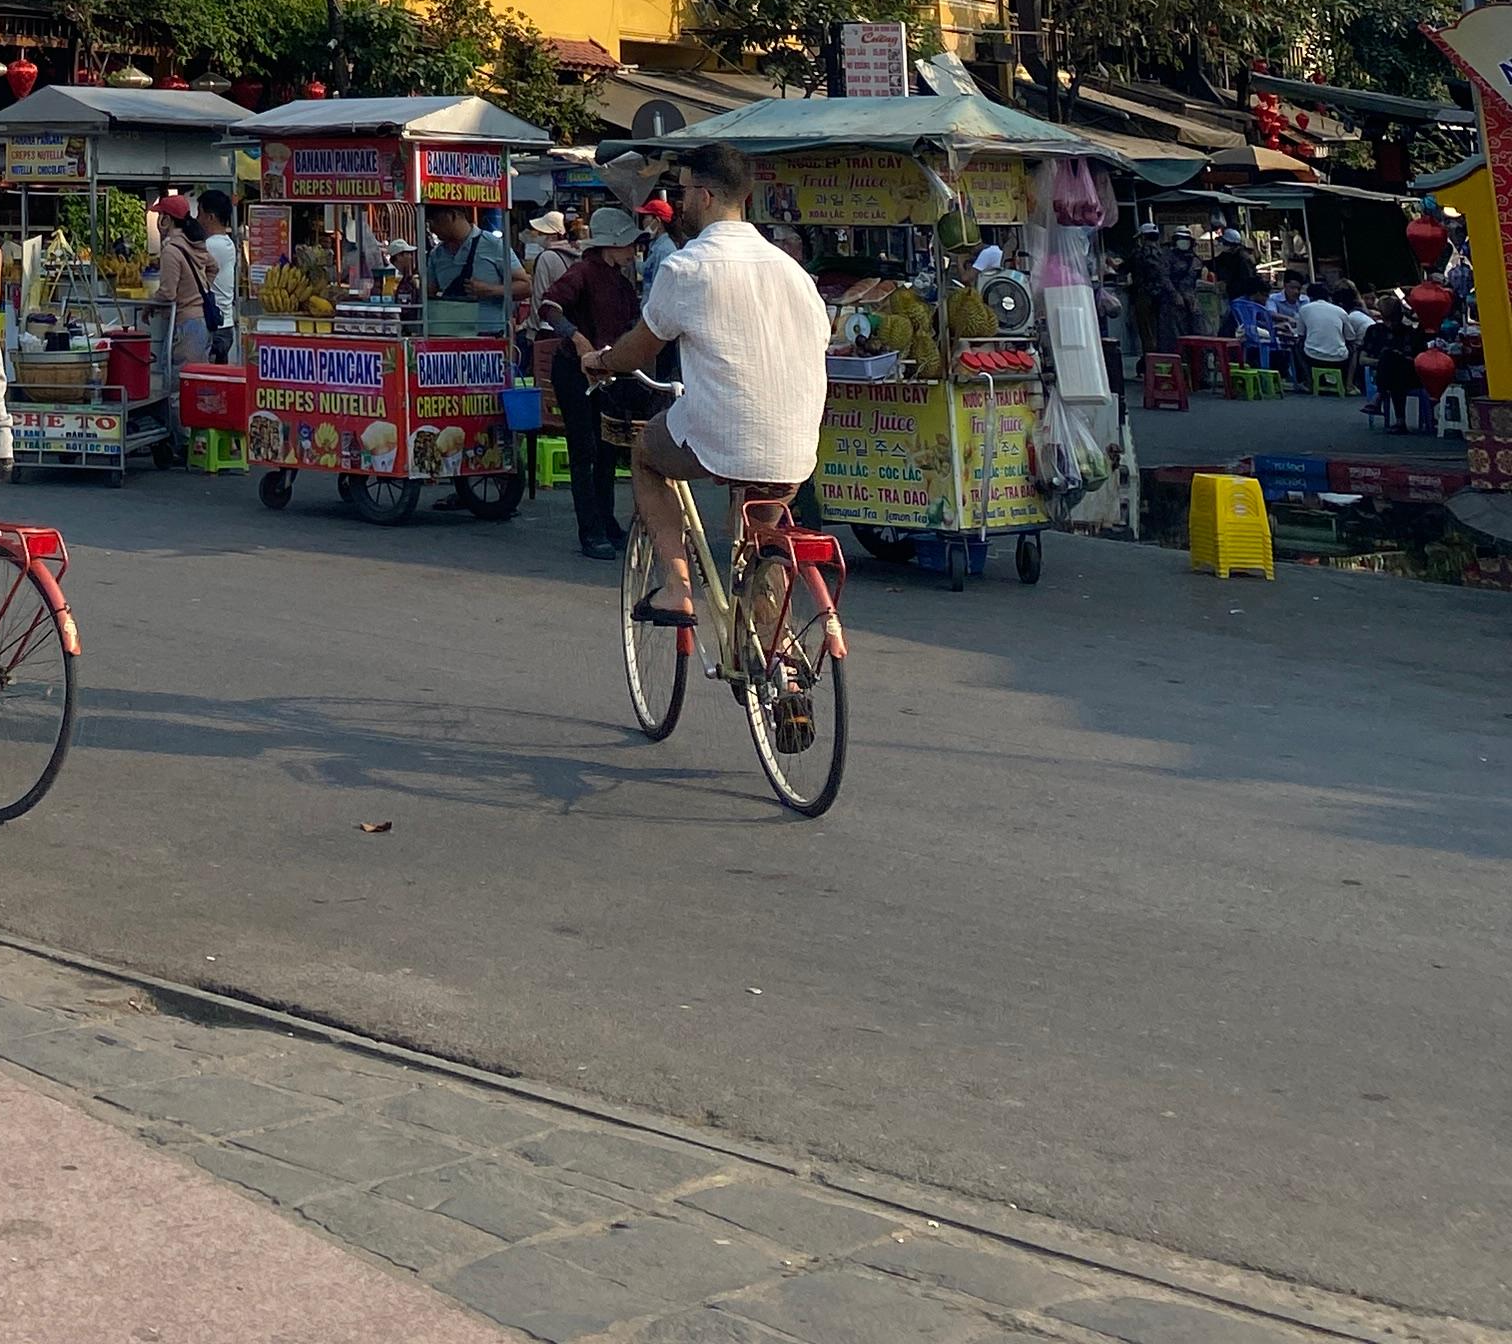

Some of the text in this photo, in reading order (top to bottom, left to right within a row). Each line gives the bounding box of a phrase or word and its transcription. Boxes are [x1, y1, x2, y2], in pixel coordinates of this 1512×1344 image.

[294, 150, 378, 173] BANANA PANCAKE
[427, 151, 502, 179] BANANA PANCAKE
[292, 180, 382, 196] CREPES NUTELLA
[428, 182, 501, 202] CREPES NUTELLA
[851, 193, 879, 206] 주스
[260, 348, 382, 386] BANANA PANCAKE
[419, 352, 504, 386] BANANA PANCAKE
[256, 388, 386, 418] CREPES NUTELLA
[417, 394, 504, 418] CREPES NUTELL
[822, 407, 915, 434] Fruit Juice
[999, 414, 1023, 436] Juice
[836, 438, 907, 457] 과일 주스
[1001, 441, 1019, 456] 주스
